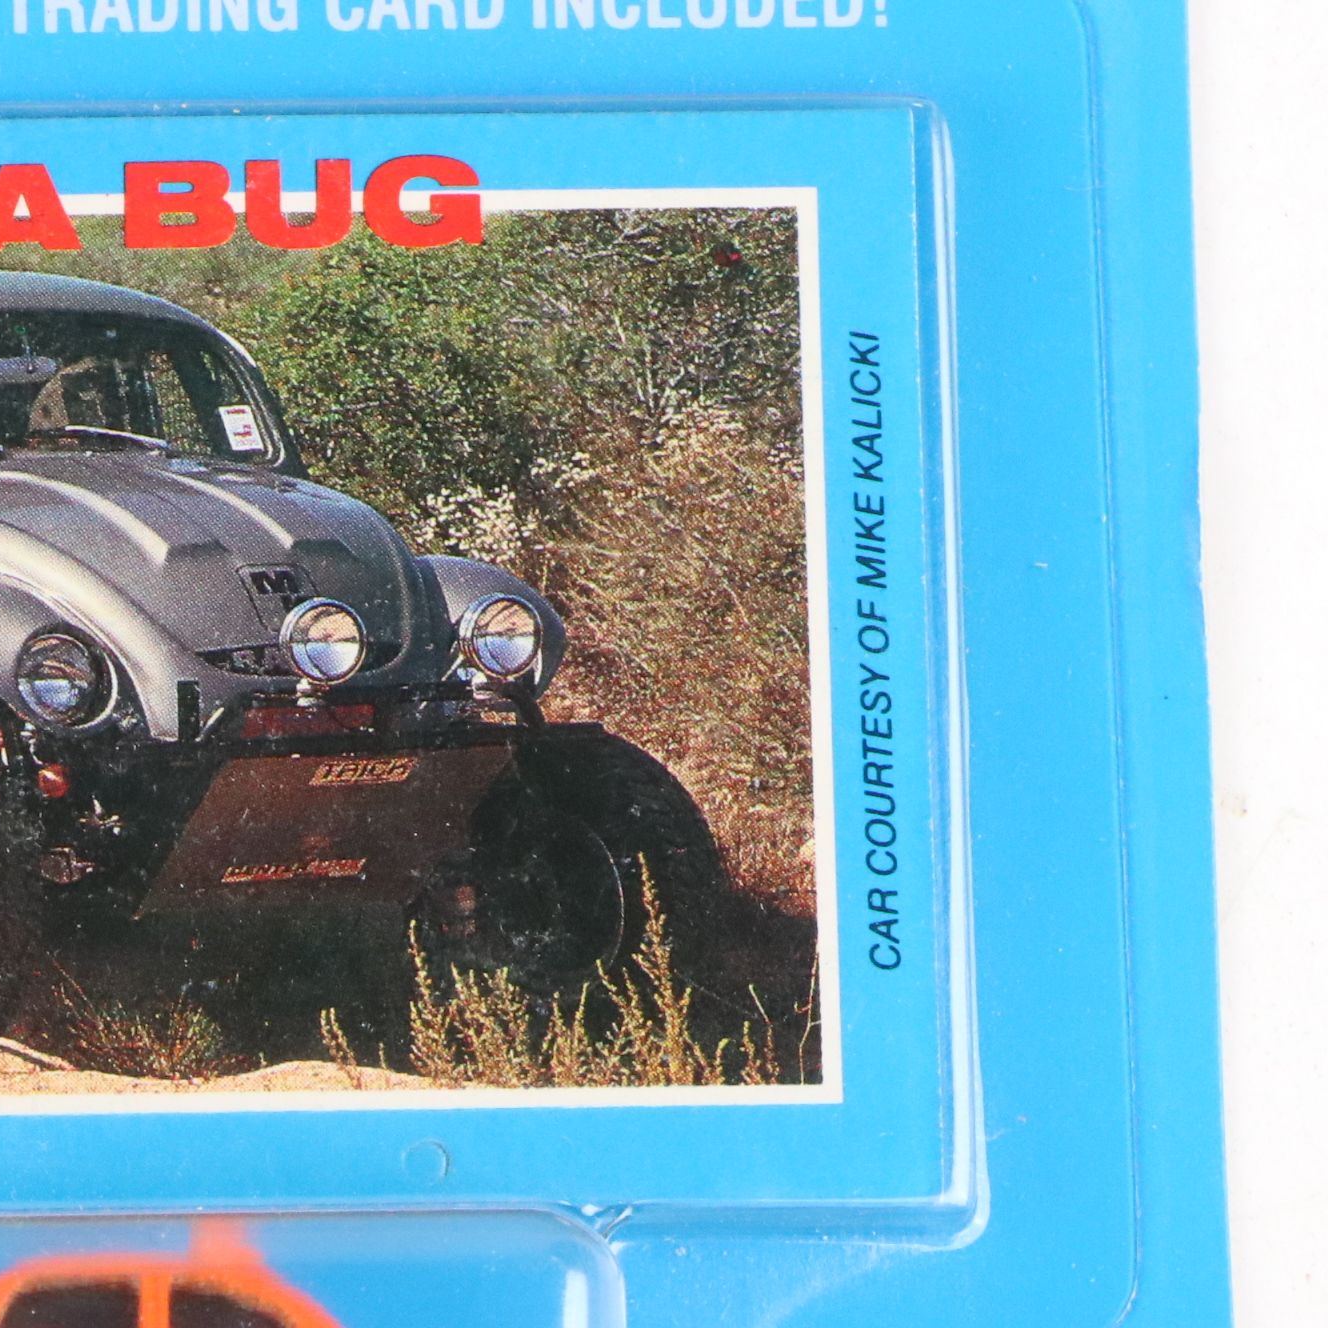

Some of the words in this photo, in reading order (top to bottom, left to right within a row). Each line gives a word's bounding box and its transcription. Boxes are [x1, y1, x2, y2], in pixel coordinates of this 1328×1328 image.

[123, 154, 484, 250] BUG
[848, 331, 884, 483] KALICKI
[853, 491, 887, 590] MIKE
[856, 600, 887, 655] OF
[859, 664, 897, 877] COURTESY
[867, 887, 901, 971] CAR
